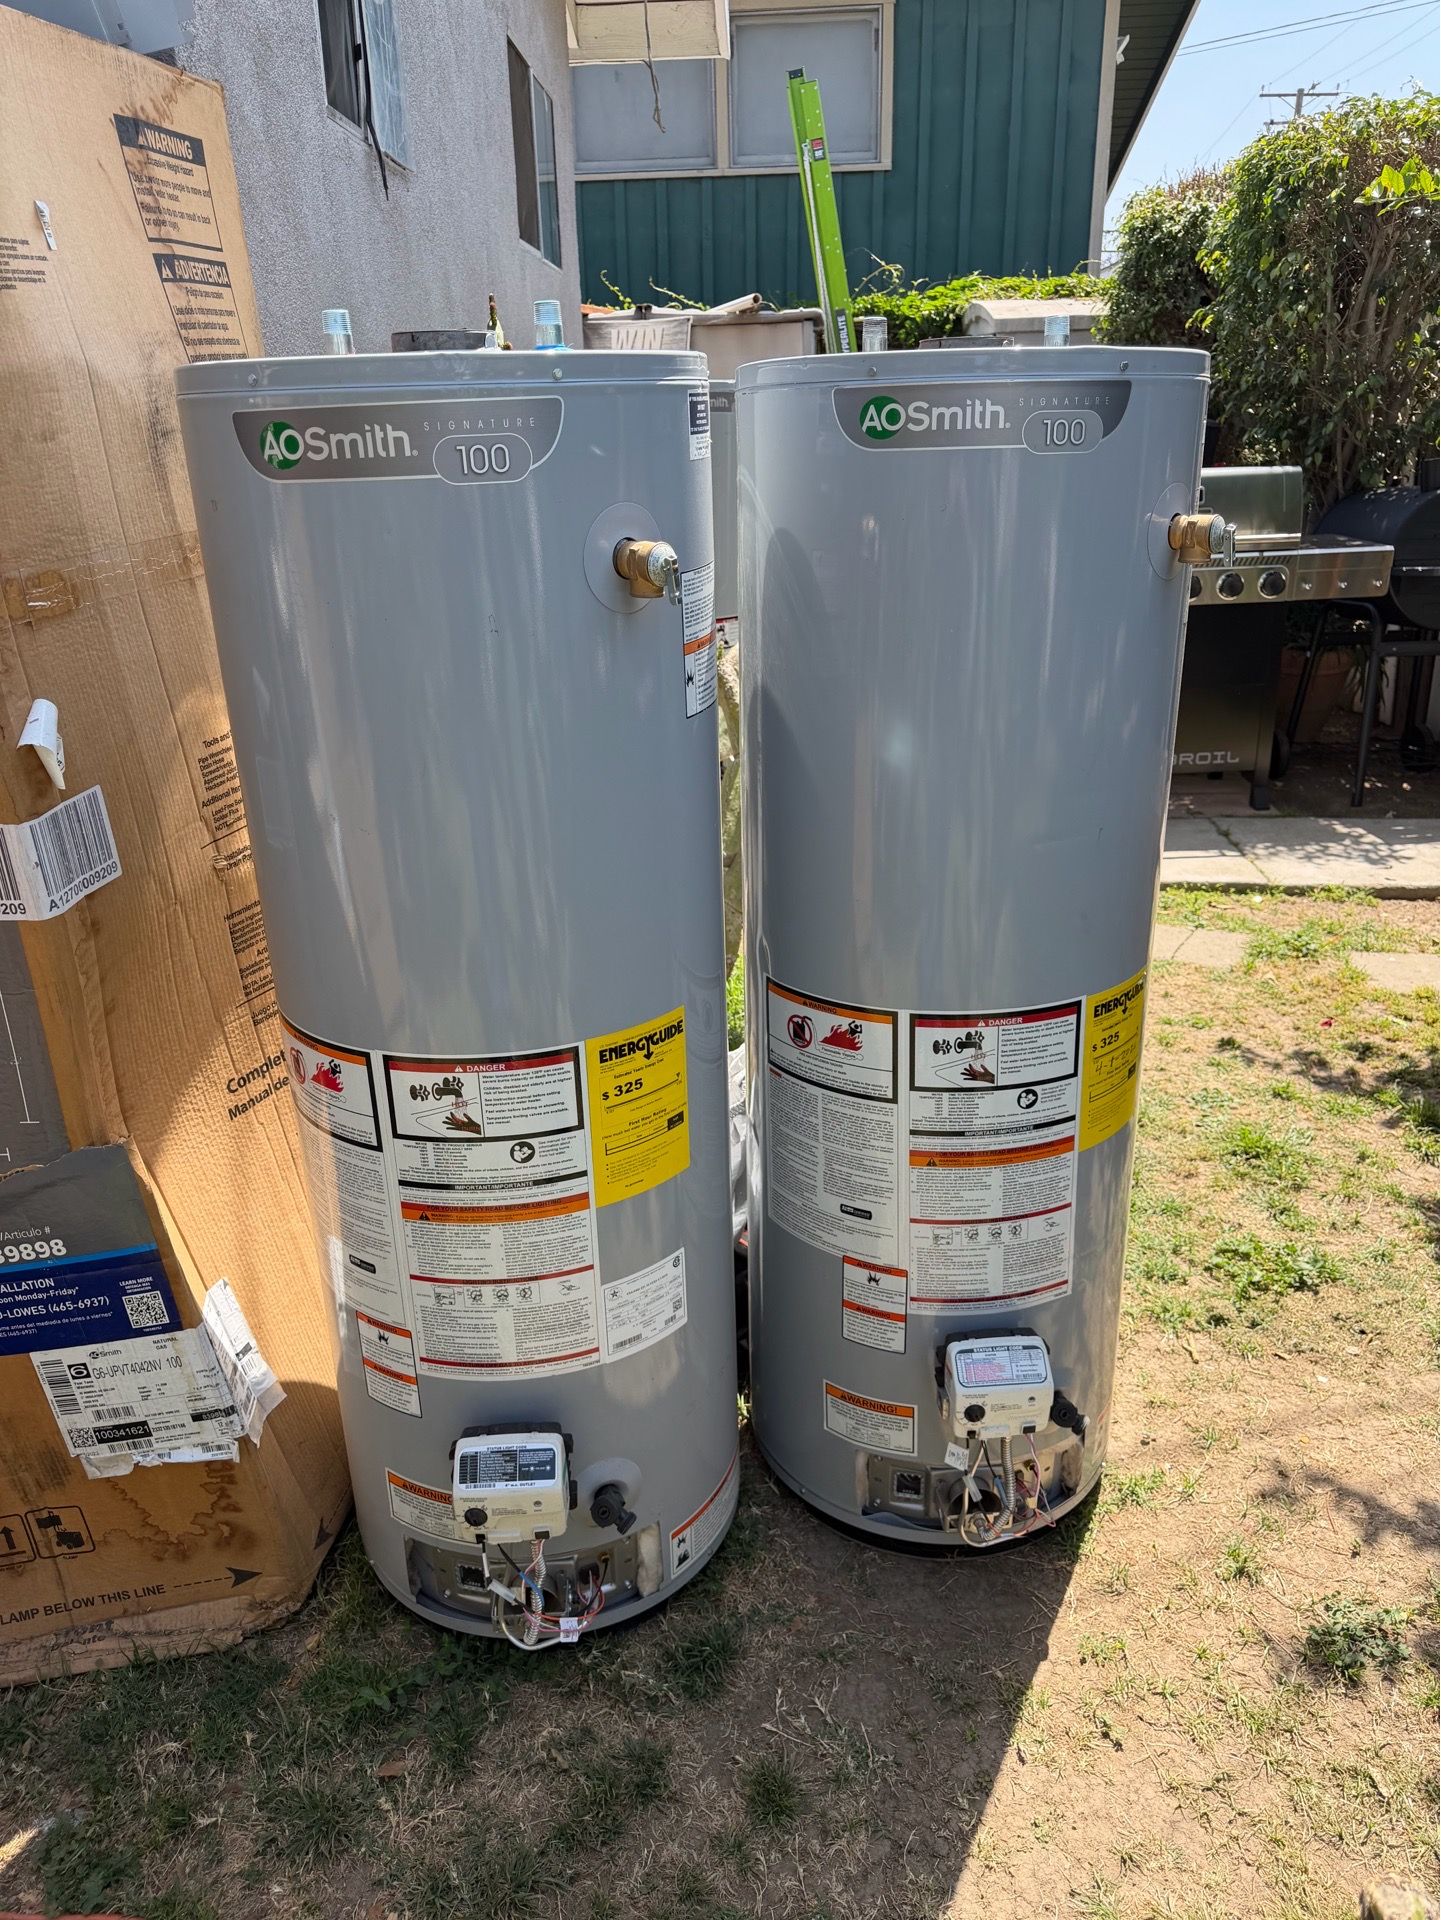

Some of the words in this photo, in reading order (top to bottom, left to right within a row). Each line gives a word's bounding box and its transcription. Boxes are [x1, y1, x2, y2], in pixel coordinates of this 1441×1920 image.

[145, 128, 193, 160] WARNING
[174, 259, 230, 284] ADVERTENCIA
[1019, 396, 1111, 406] SIGNATURE
[423, 415, 537, 431] SIGNATURE
[1044, 418, 1087, 447] 100
[456, 443, 511, 475] 100
[202, 737, 219, 749] Tools
[202, 789, 231, 808] Additional
[0, 902, 26, 916] 209
[808, 1000, 837, 1014] WARNING
[988, 1018, 1022, 1026] DANGER
[599, 1019, 684, 1064] ENERGYGUIDE
[1100, 1031, 1120, 1049] 325
[466, 1063, 506, 1072] DANGER
[228, 1084, 272, 1121] Manual
[274, 1074, 290, 1091] de
[602, 1092, 610, 1101] $
[613, 1078, 643, 1097] 325
[454, 1181, 534, 1190] IMPORTANT/IMPORTANTE
[862, 1262, 892, 1274] WARNING
[0, 1278, 54, 1293] ALLATION
[48, 1296, 110, 1314] (465-6937)
[861, 1306, 890, 1319] WARNING
[152, 1336, 178, 1344] NATURAL
[70, 1365, 88, 1377] 6
[92, 1359, 162, 1379] G6-UPVT4042NV
[166, 1356, 183, 1368] 100
[846, 1394, 898, 1414] WARNING!
[95, 1424, 150, 1440] 100341621
[0, 1608, 39, 1625] LAMP
[43, 1596, 94, 1616] BELOW
[98, 1590, 131, 1605] THIS
[135, 1583, 166, 1599] LINE
